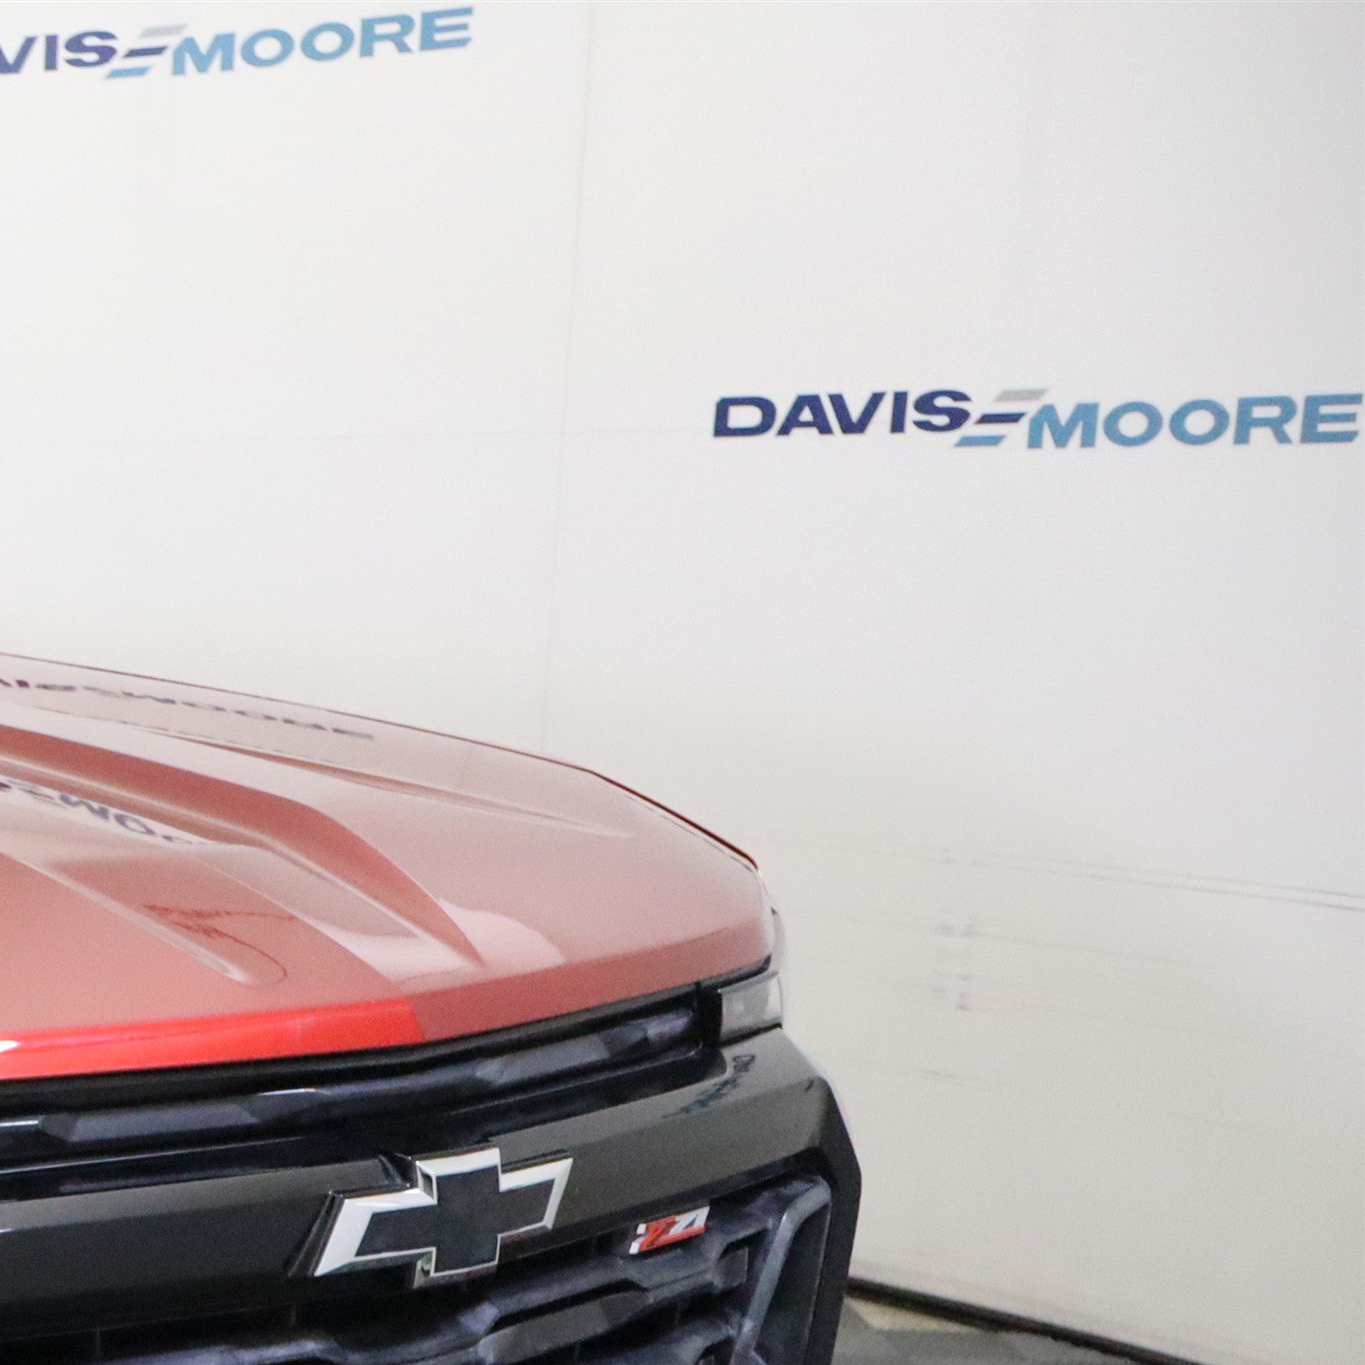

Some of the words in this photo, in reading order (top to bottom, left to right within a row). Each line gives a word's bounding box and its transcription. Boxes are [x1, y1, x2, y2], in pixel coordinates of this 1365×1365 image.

[172, 7, 474, 75] MOORE
[713, 388, 973, 438] DAVIS
[1026, 391, 1364, 449] MOORE
